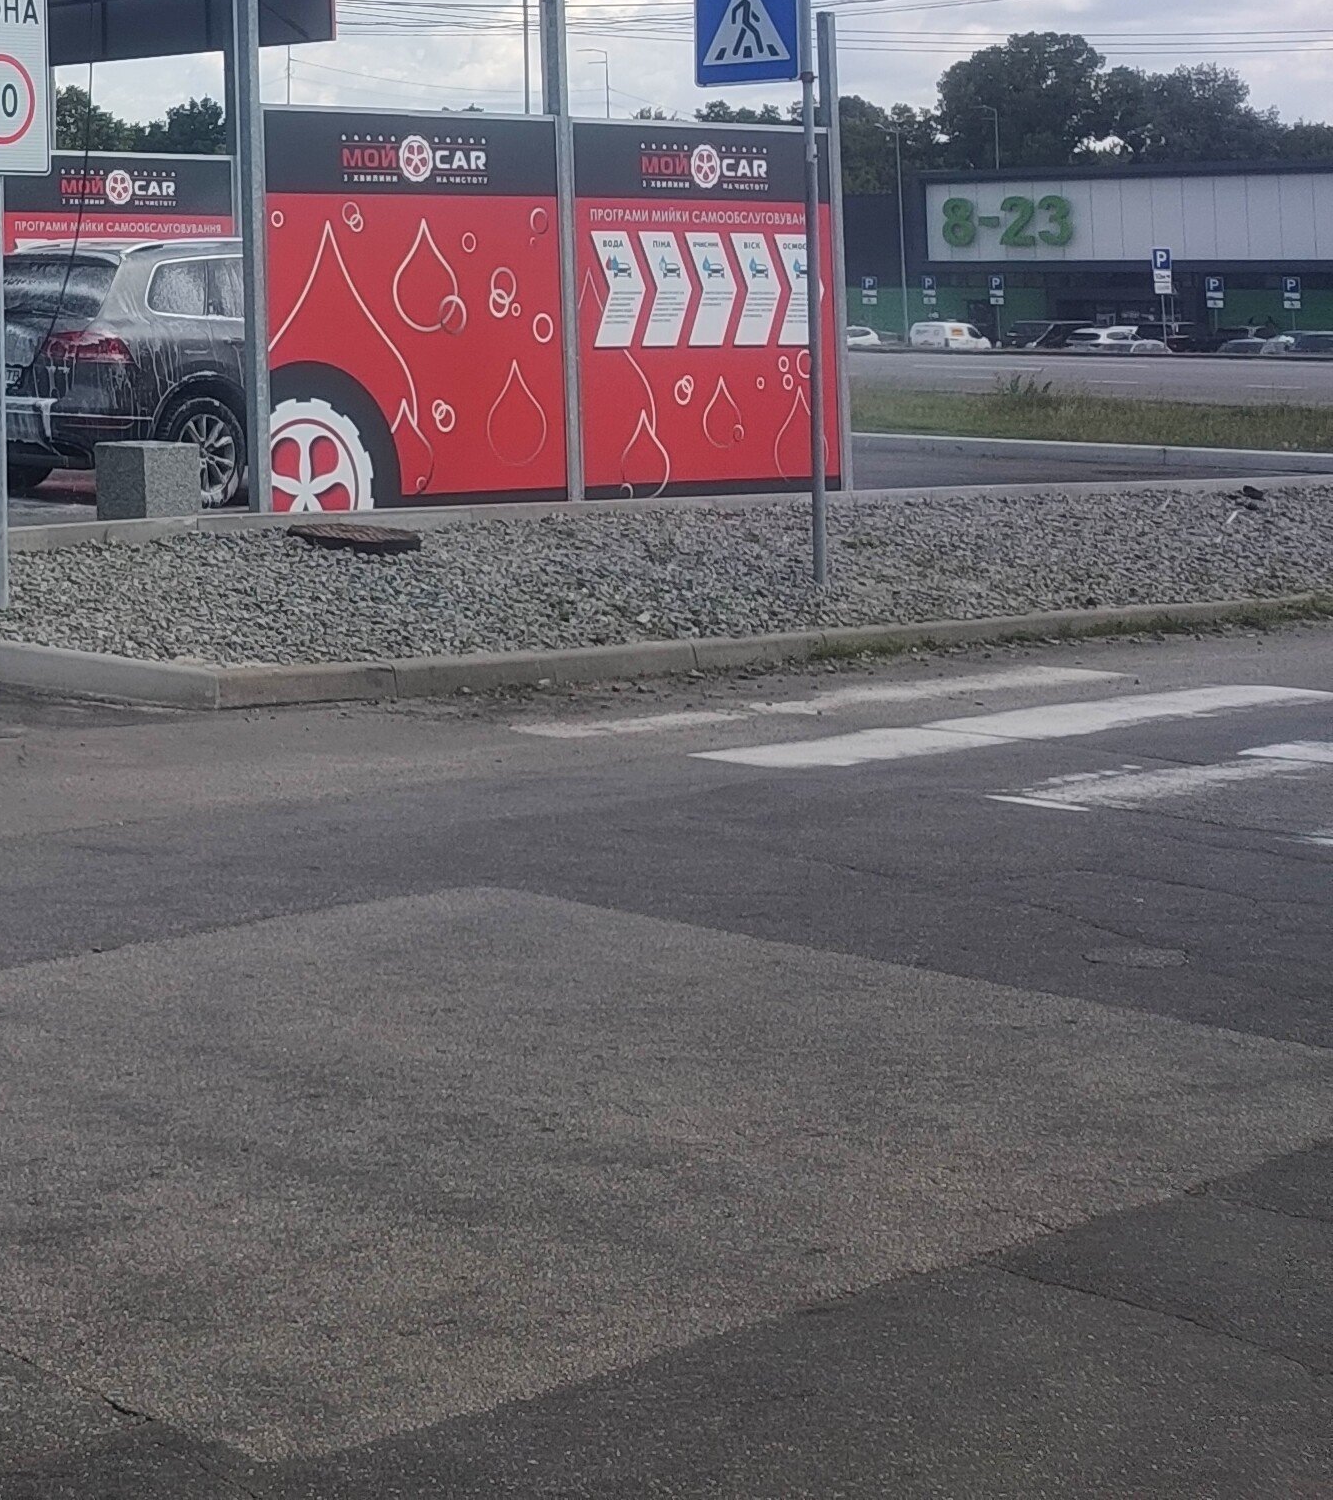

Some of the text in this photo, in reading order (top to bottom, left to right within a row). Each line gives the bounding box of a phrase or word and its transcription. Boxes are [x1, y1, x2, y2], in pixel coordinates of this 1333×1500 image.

[342, 145, 487, 170] МОЙ CAR
[641, 153, 768, 178] МОЙ CAR
[353, 174, 398, 182] ХВИЛИНИ
[61, 176, 175, 196] МОЙ CAR
[590, 208, 648, 222] ПРОГРАМИ
[651, 207, 690, 222] МИЙКИ
[942, 195, 1074, 247] 8-23
[14, 219, 222, 234] ПРОГРАМИ МИЙКИ САМООБСЛУГОВУВАННЯ
[602, 240, 624, 248] ВОДА
[652, 240, 671, 248] ПІНА
[743, 241, 760, 249] ВІСК
[1156, 250, 1167, 268] P
